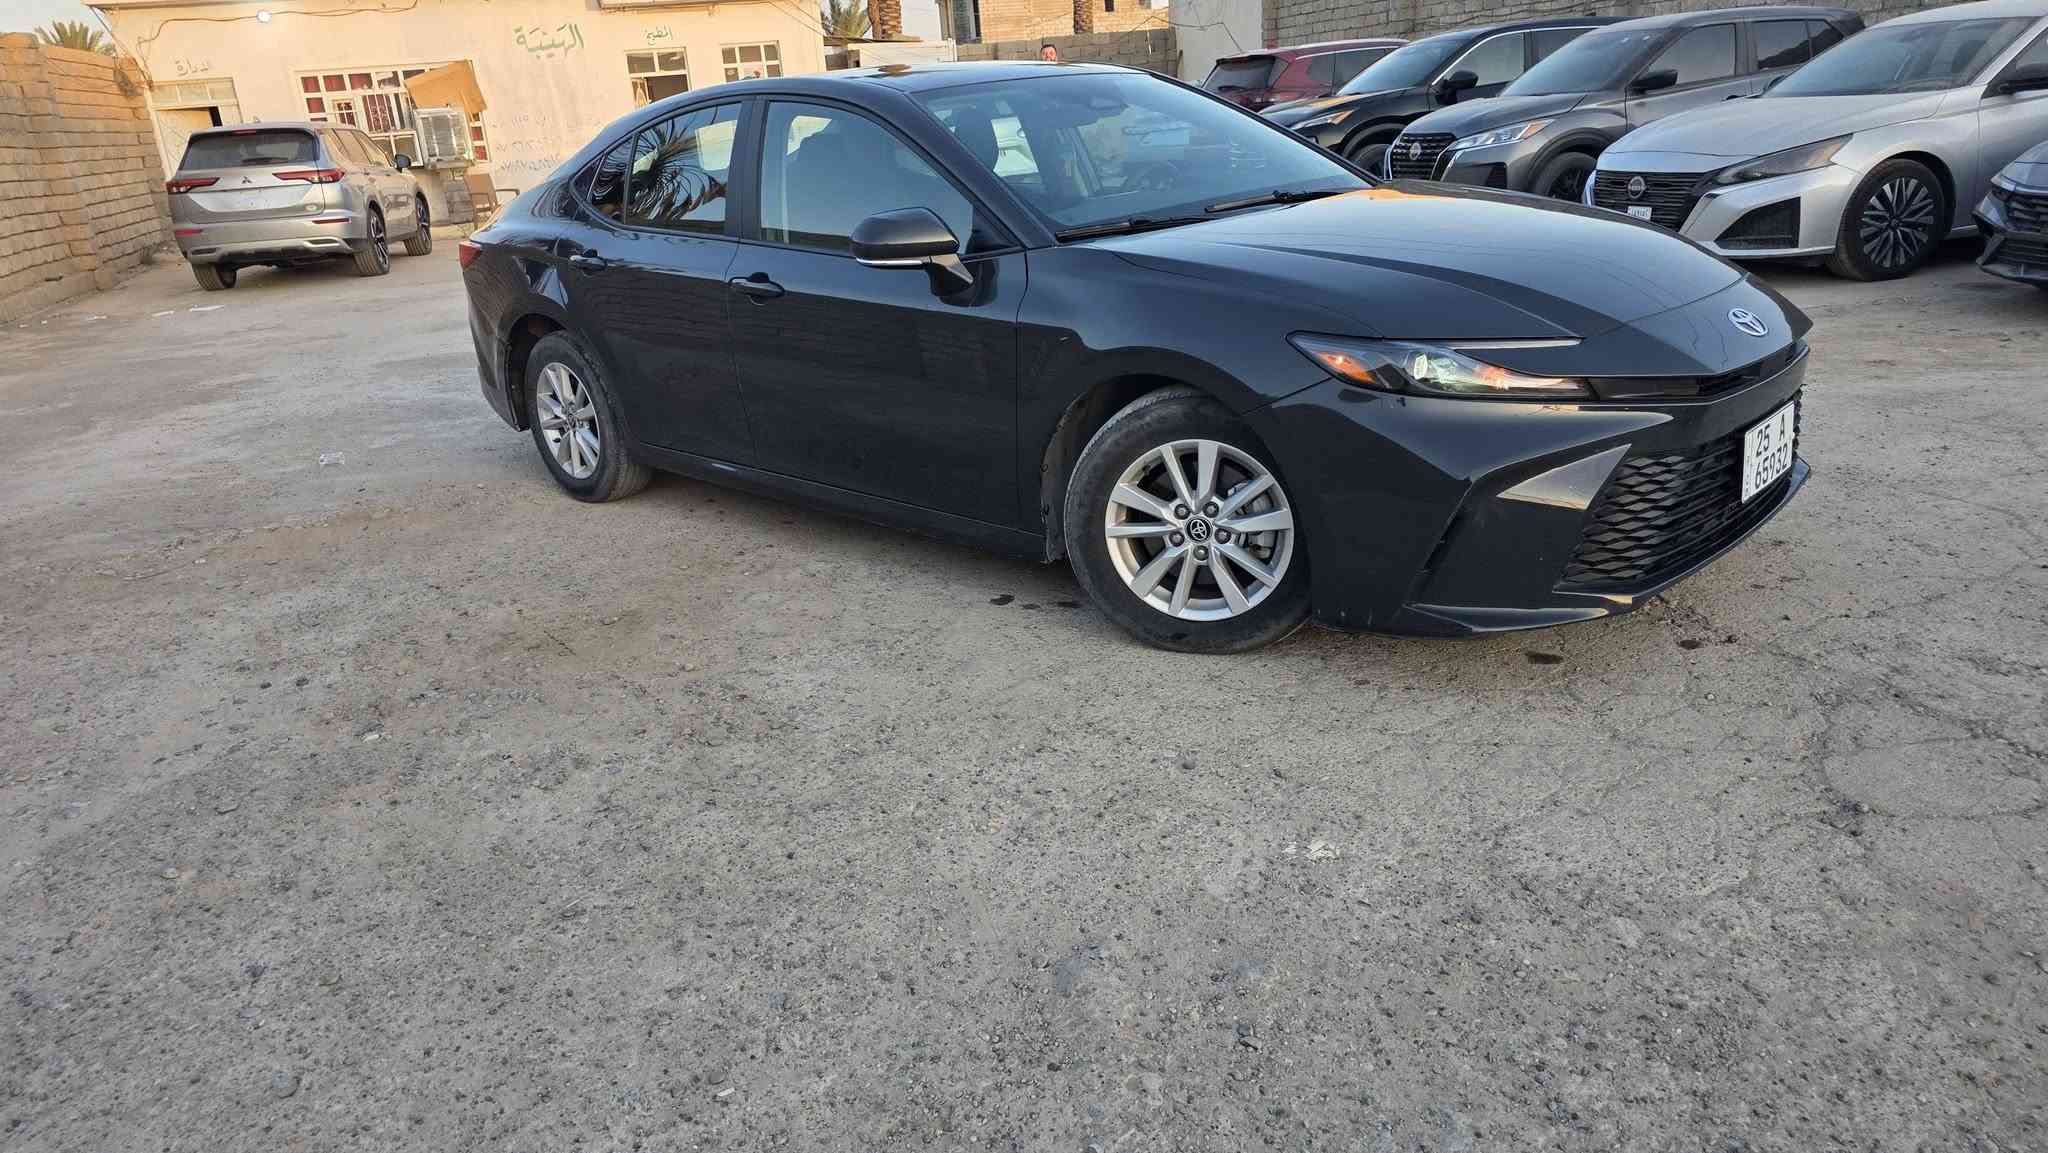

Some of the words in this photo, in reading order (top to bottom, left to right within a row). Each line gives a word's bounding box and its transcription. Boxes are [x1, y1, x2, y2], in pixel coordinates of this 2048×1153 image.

[1756, 424, 1771, 458] 25
[1779, 414, 1785, 442] A
[1755, 443, 1788, 490] 65932
